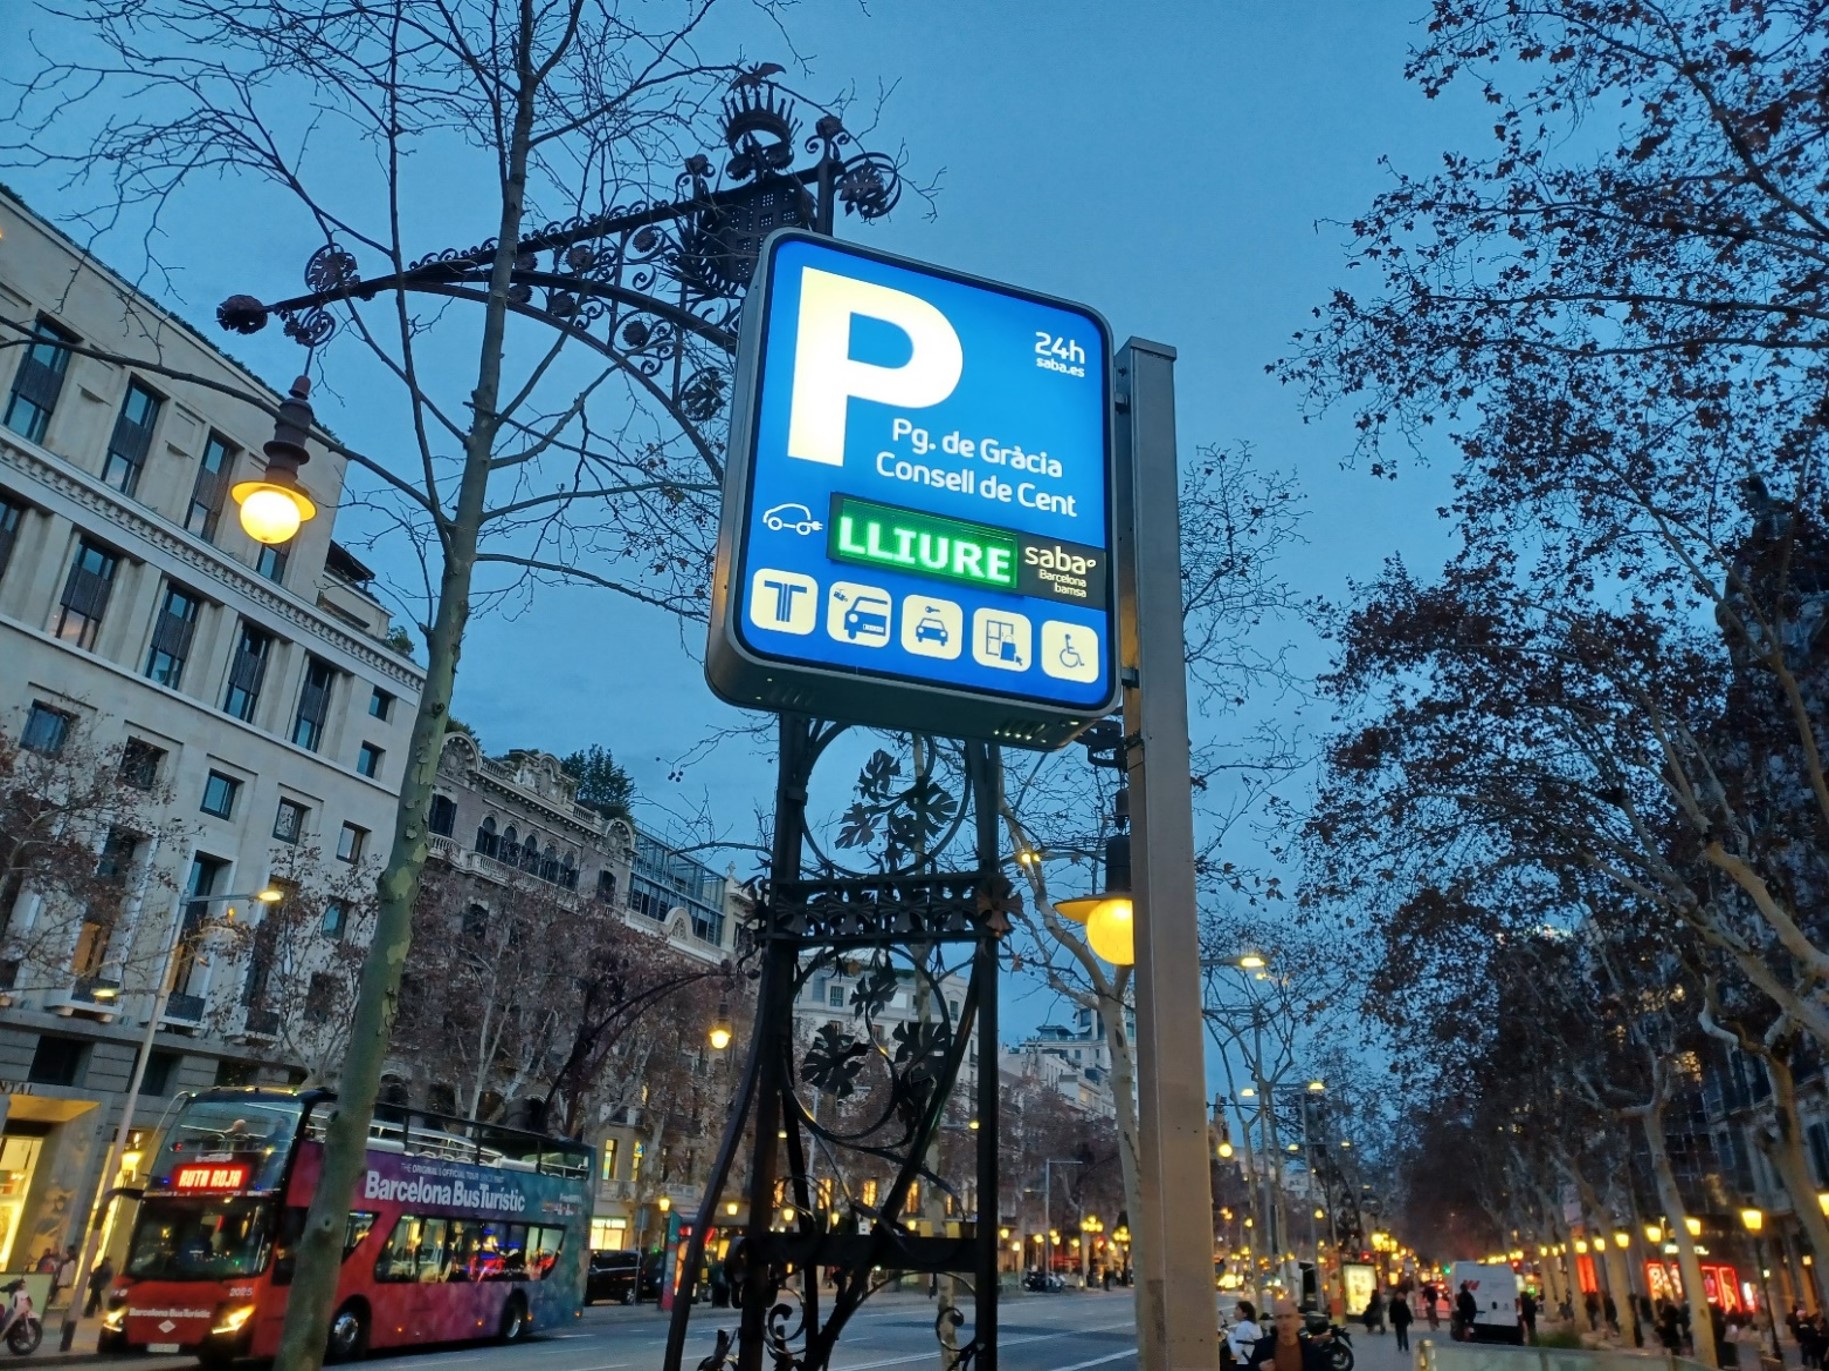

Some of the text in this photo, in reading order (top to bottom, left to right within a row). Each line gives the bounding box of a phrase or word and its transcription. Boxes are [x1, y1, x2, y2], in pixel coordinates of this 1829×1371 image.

[1035, 331, 1085, 365] 24h
[787, 266, 963, 467] P
[1036, 357, 1085, 378] saba.es
[892, 418, 1063, 477] Pg. de Gràcia
[876, 451, 1077, 517] Consell de Cent
[838, 516, 1011, 583] LLIURE
[1039, 568, 1087, 587] Barcelona
[1054, 582, 1087, 598] bamsa
[178, 1169, 242, 1187] RUTA ROJA
[365, 1170, 451, 1206] Barcelona
